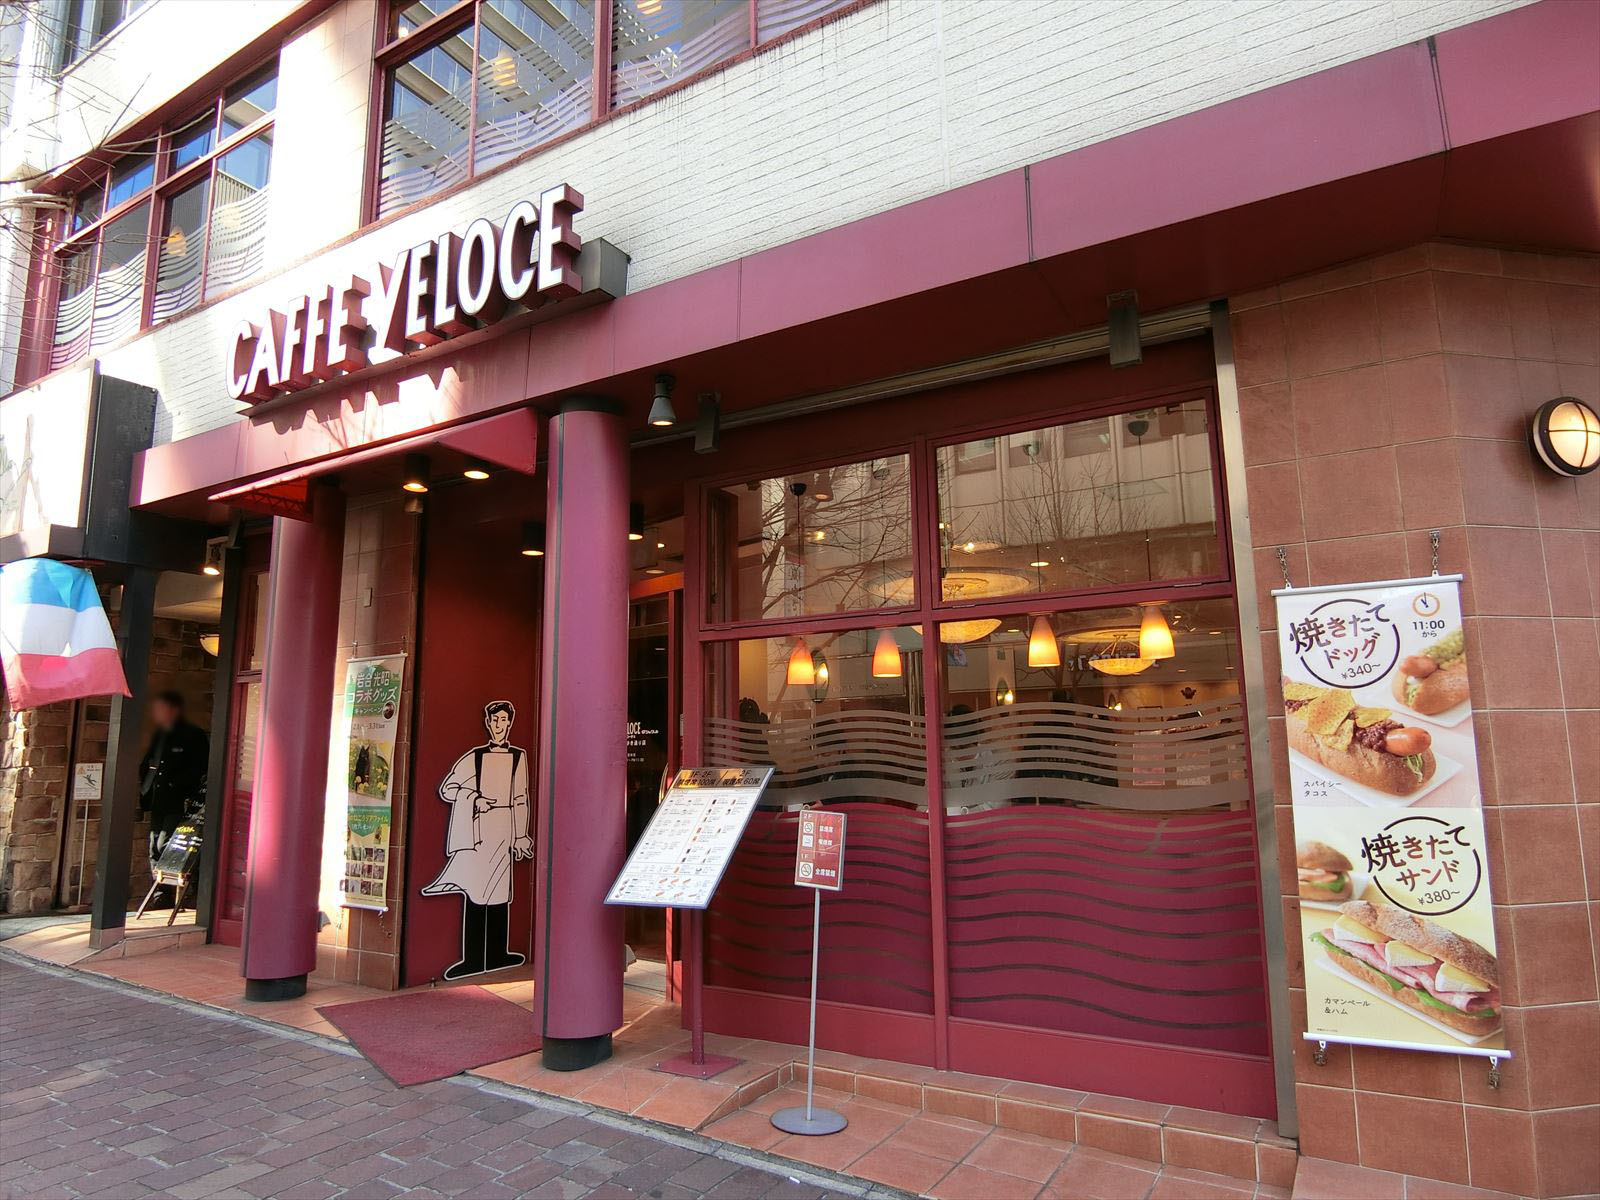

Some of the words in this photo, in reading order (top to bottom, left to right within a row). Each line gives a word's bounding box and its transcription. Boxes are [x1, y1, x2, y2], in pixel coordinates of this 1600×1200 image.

[226, 275, 370, 400] CAFFE
[364, 183, 583, 364] VELOCE
[1290, 603, 1390, 654] 焼きたて
[1412, 620, 1445, 631] 11:00
[1324, 632, 1381, 669] ドッグ
[346, 687, 398, 704] コラボグッズ
[354, 706, 383, 715] キャンペーン
[627, 722, 641, 735] LOCE
[739, 769, 752, 777] 2F
[1304, 780, 1342, 788] スパイシー
[1304, 790, 1328, 798] タコス
[1361, 826, 1470, 873] 焼きたて
[1396, 860, 1460, 892] サンド
[1324, 997, 1370, 1007] カマンベール
[1324, 1006, 1348, 1015] &ハム
